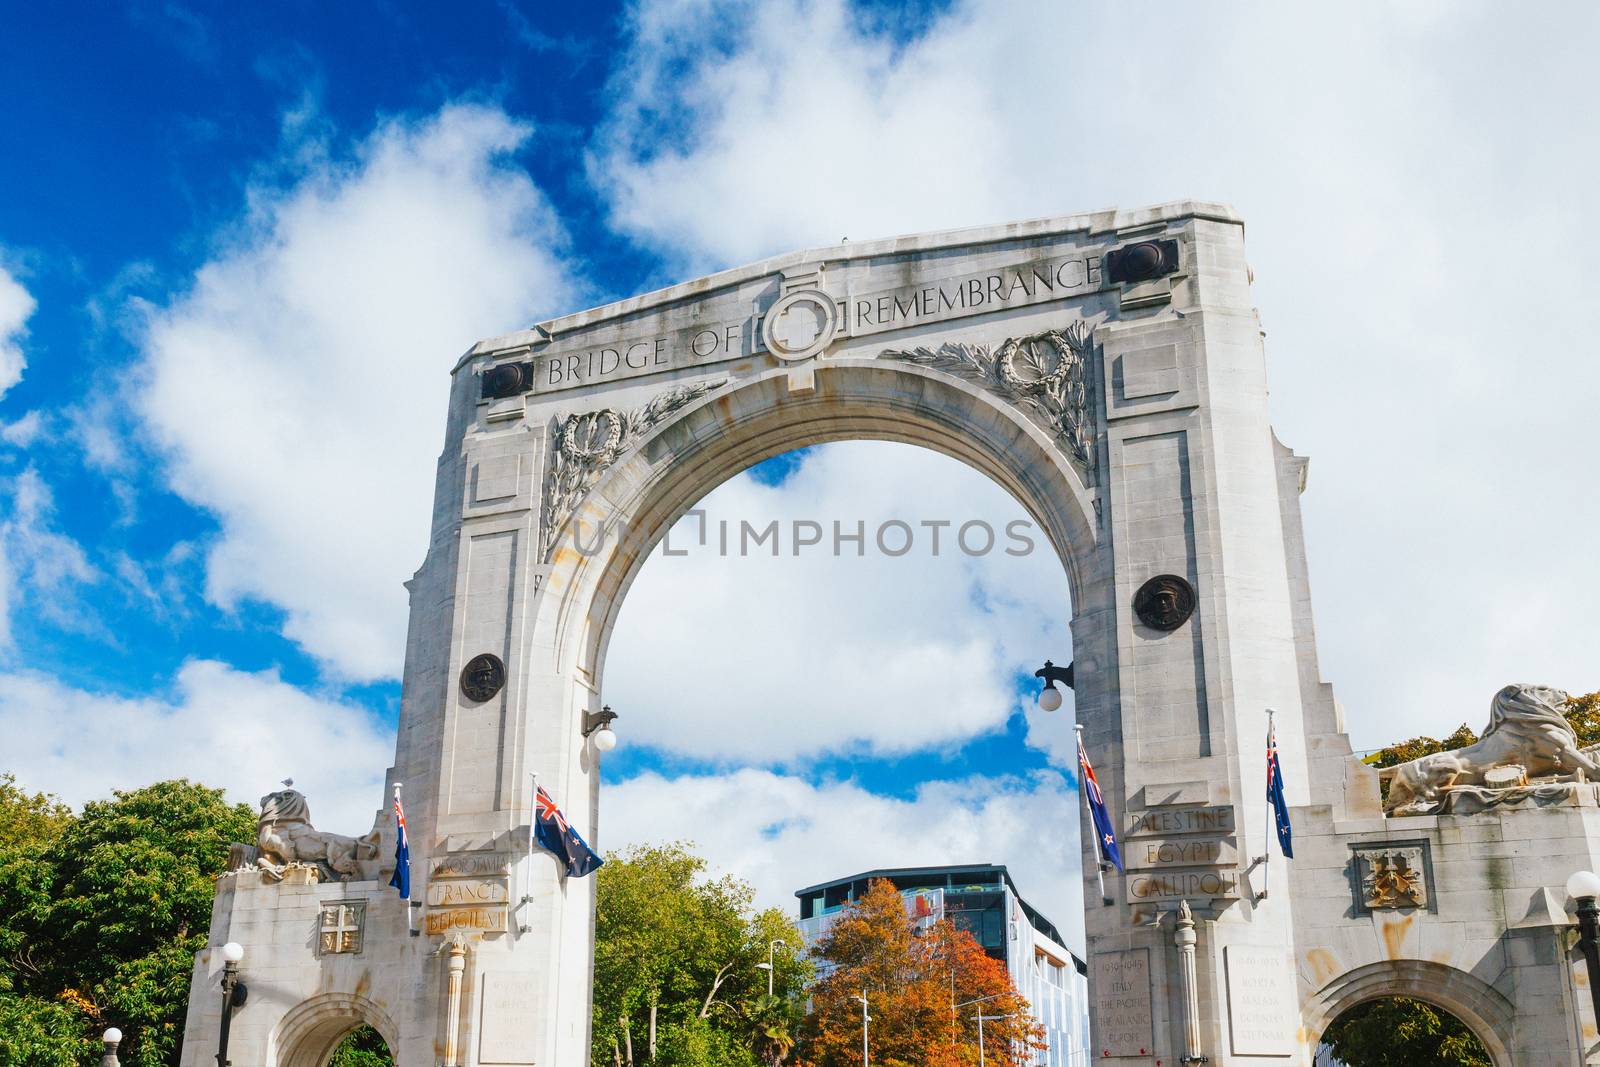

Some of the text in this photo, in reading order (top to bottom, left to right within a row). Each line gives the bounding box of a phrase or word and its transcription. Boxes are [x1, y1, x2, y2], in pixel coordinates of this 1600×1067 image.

[548, 255, 1100, 385] BRIDGE OF REMEMBRANCE
[1130, 808, 1229, 833] PALESTINE
[1146, 841, 1214, 864] EGYPT
[436, 881, 498, 902] FRANCE
[1130, 872, 1236, 898] GALLIPOLI
[429, 910, 502, 930] BELGIUM
[1112, 980, 1134, 993] ITALY
[1101, 1000, 1113, 1010] THE
